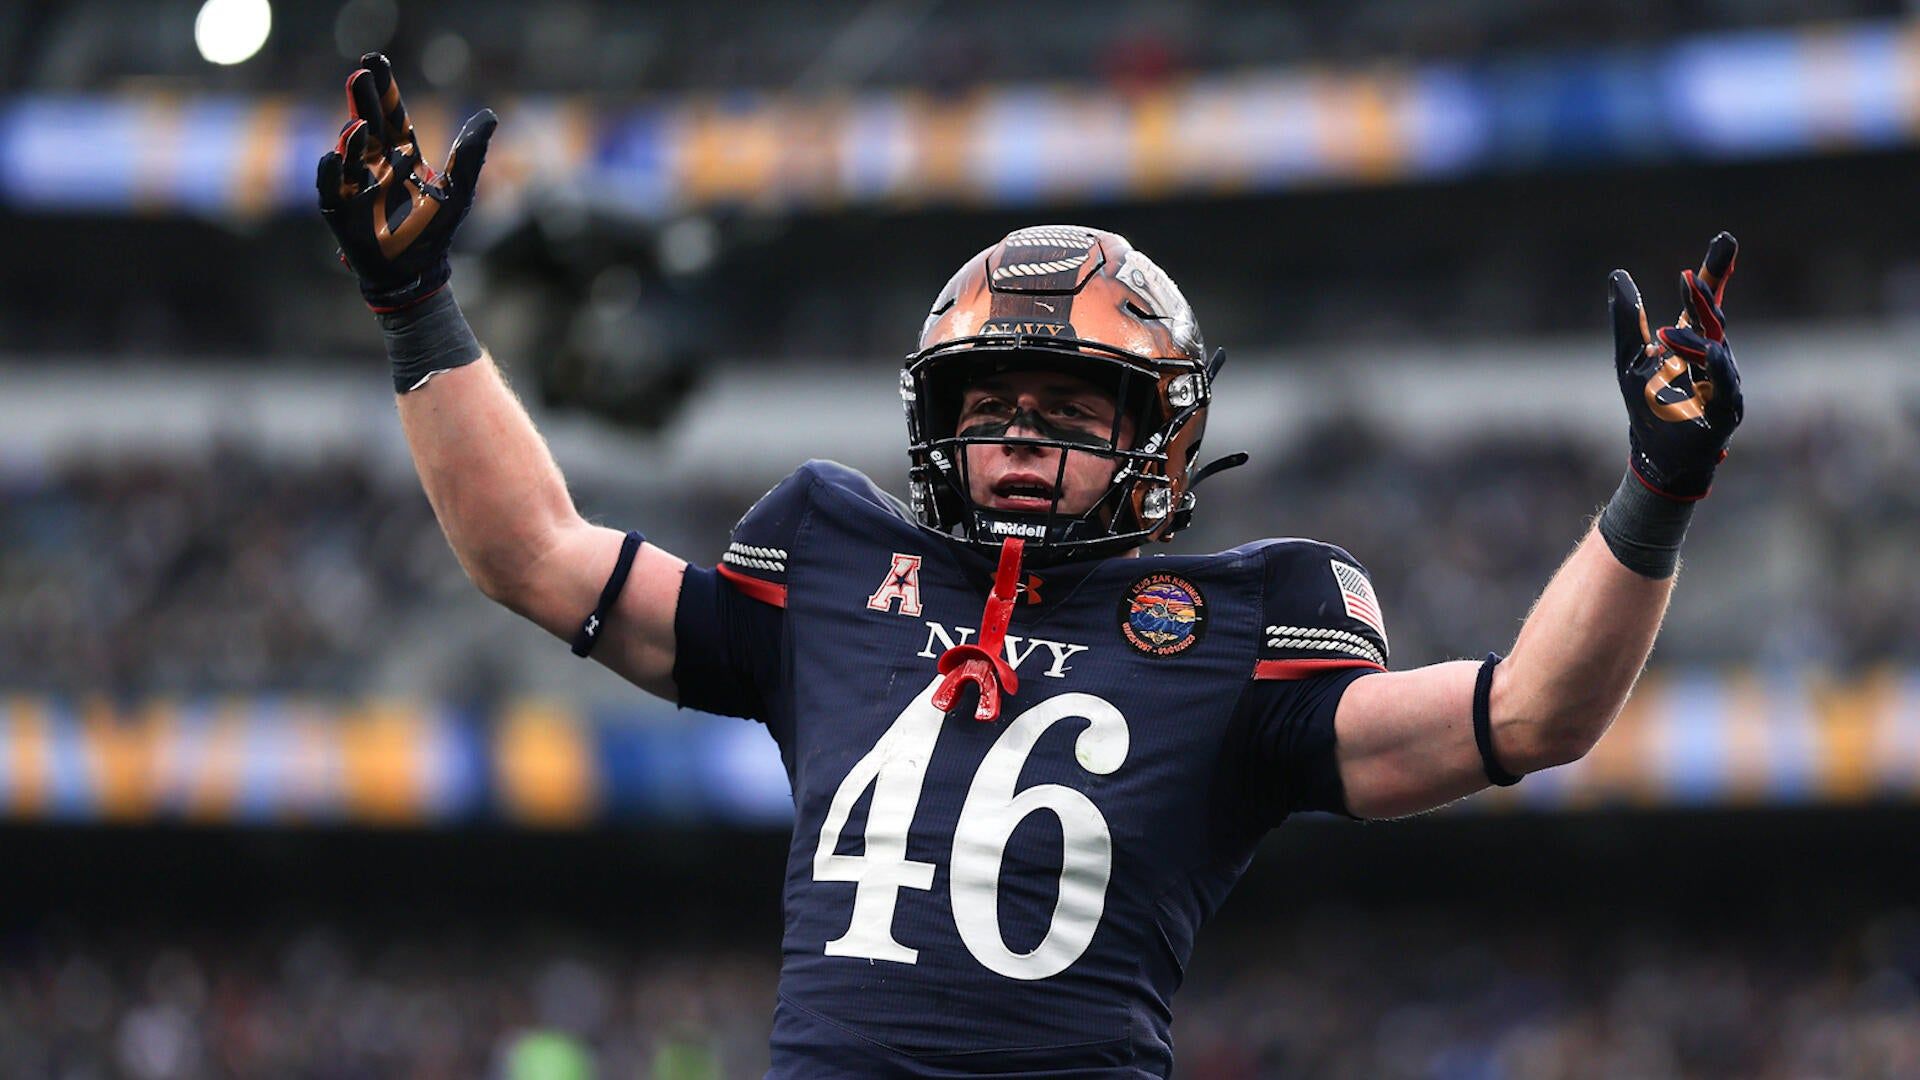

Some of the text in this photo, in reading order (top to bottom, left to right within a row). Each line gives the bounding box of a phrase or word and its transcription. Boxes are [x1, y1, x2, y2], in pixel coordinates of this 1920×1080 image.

[985, 322, 1065, 341] NAVY
[992, 521, 1047, 538] Riddell
[1152, 575, 1171, 583] ZAK
[1172, 577, 1203, 606] KENNEDY
[917, 621, 1088, 678] NVY
[813, 674, 1130, 980] 46
